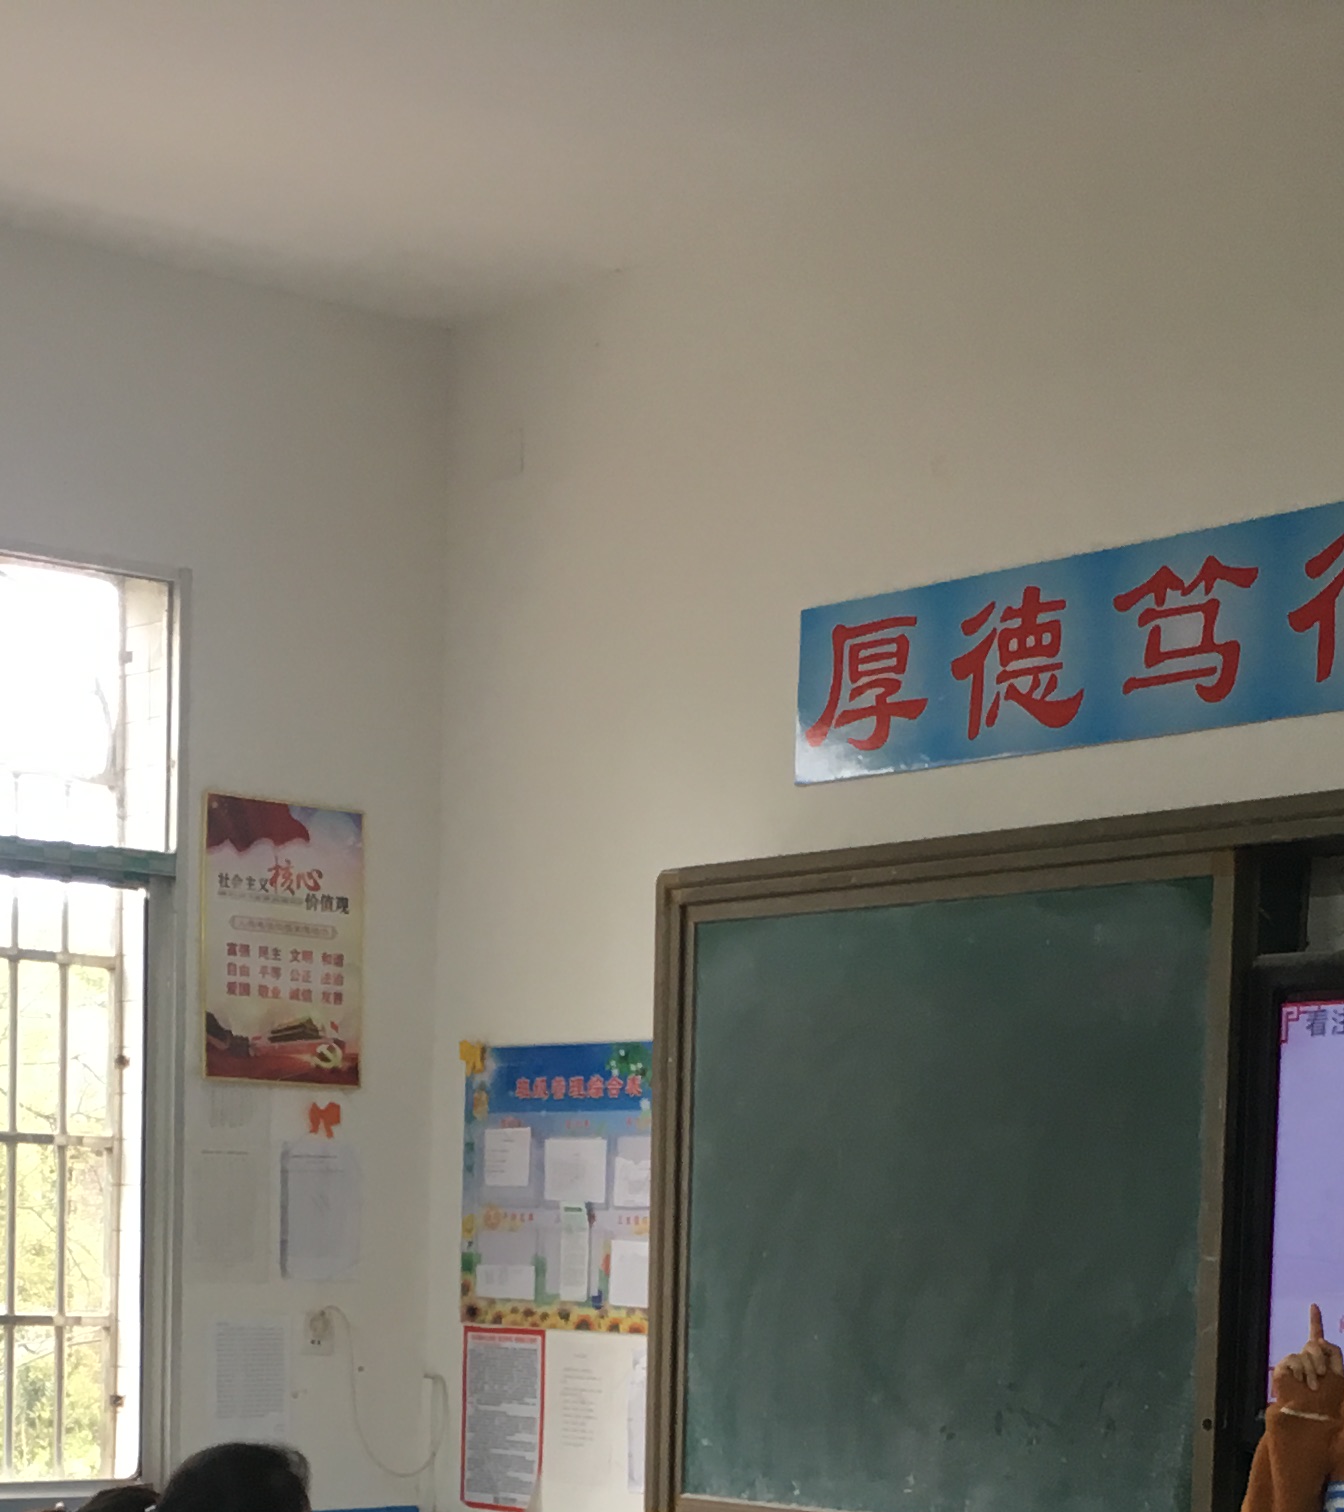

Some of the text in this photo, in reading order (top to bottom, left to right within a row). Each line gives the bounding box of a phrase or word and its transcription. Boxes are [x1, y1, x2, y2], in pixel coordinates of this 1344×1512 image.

[267, 855, 324, 896] 核心
[305, 893, 350, 915] 价值观
[258, 945, 282, 961] 民主
[289, 948, 313, 964] 文明
